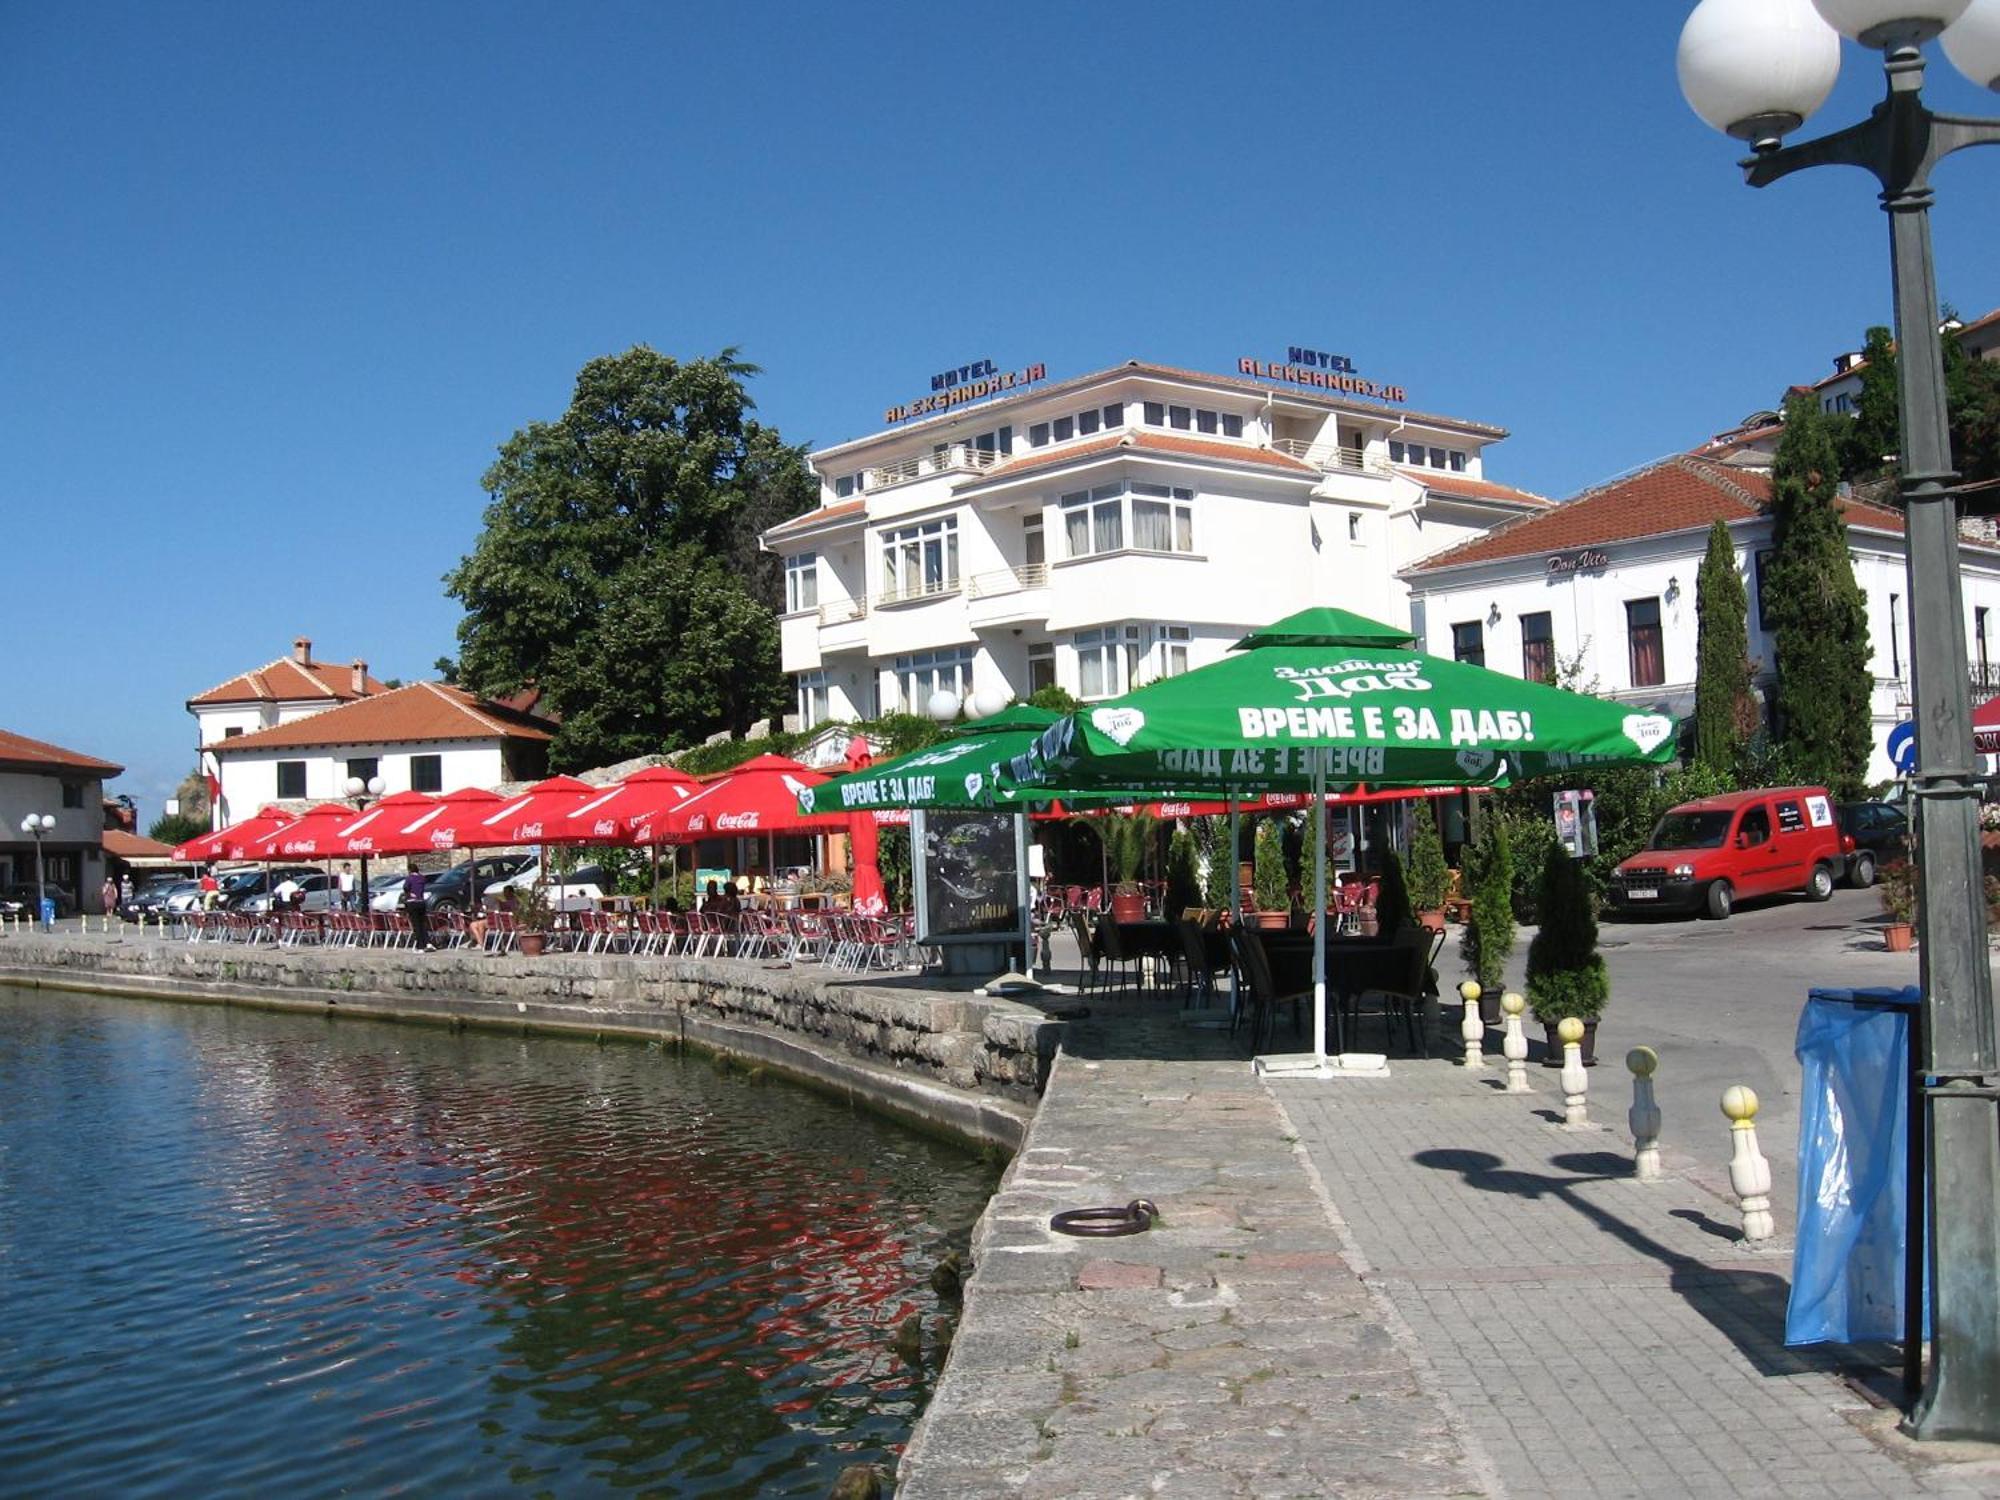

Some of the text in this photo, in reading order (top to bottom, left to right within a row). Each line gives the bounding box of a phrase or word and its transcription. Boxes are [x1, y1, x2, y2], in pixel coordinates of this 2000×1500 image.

[931, 359, 998, 391] HOTEL
[1288, 347, 1358, 374] HOTEL
[885, 362, 1046, 424] ALEKSANDRIJA
[1238, 357, 1408, 402] ALEKSANDRIJA
[1547, 556, 1577, 573] Don
[1289, 670, 1433, 702] Даб
[1238, 706, 1535, 746] ВРЕМЕ Е ЗА ДАБ!
[841, 780, 879, 806] ВРЕМЕ
[879, 779, 888, 802] Е
[889, 778, 906, 801] ЗА
[907, 776, 936, 804] ДАБ!
